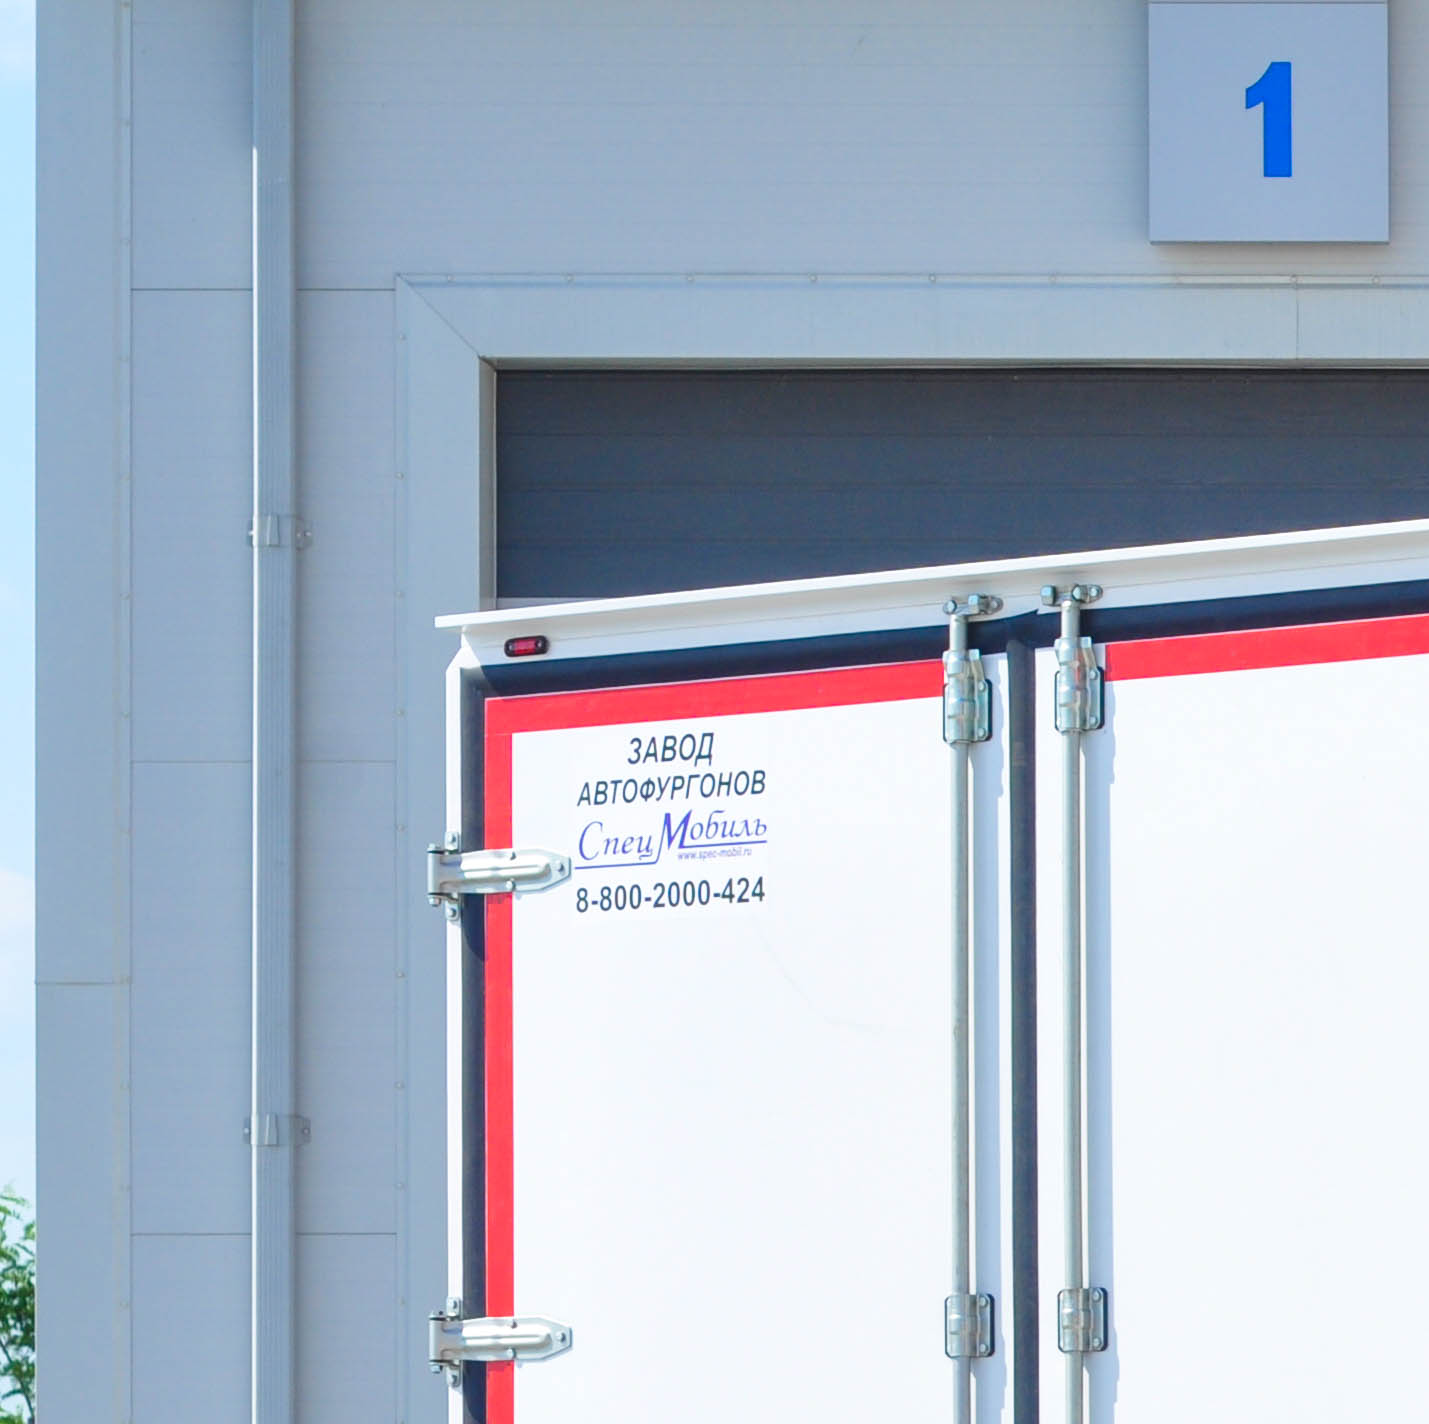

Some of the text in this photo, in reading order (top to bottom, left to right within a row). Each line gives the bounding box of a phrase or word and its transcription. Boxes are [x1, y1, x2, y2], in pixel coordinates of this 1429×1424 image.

[1245, 61, 1293, 178] 1
[627, 732, 714, 767] ЗАВОД
[576, 769, 766, 807] АВТОФУРГОНОВ
[576, 876, 766, 913] 8-800-2000-424
